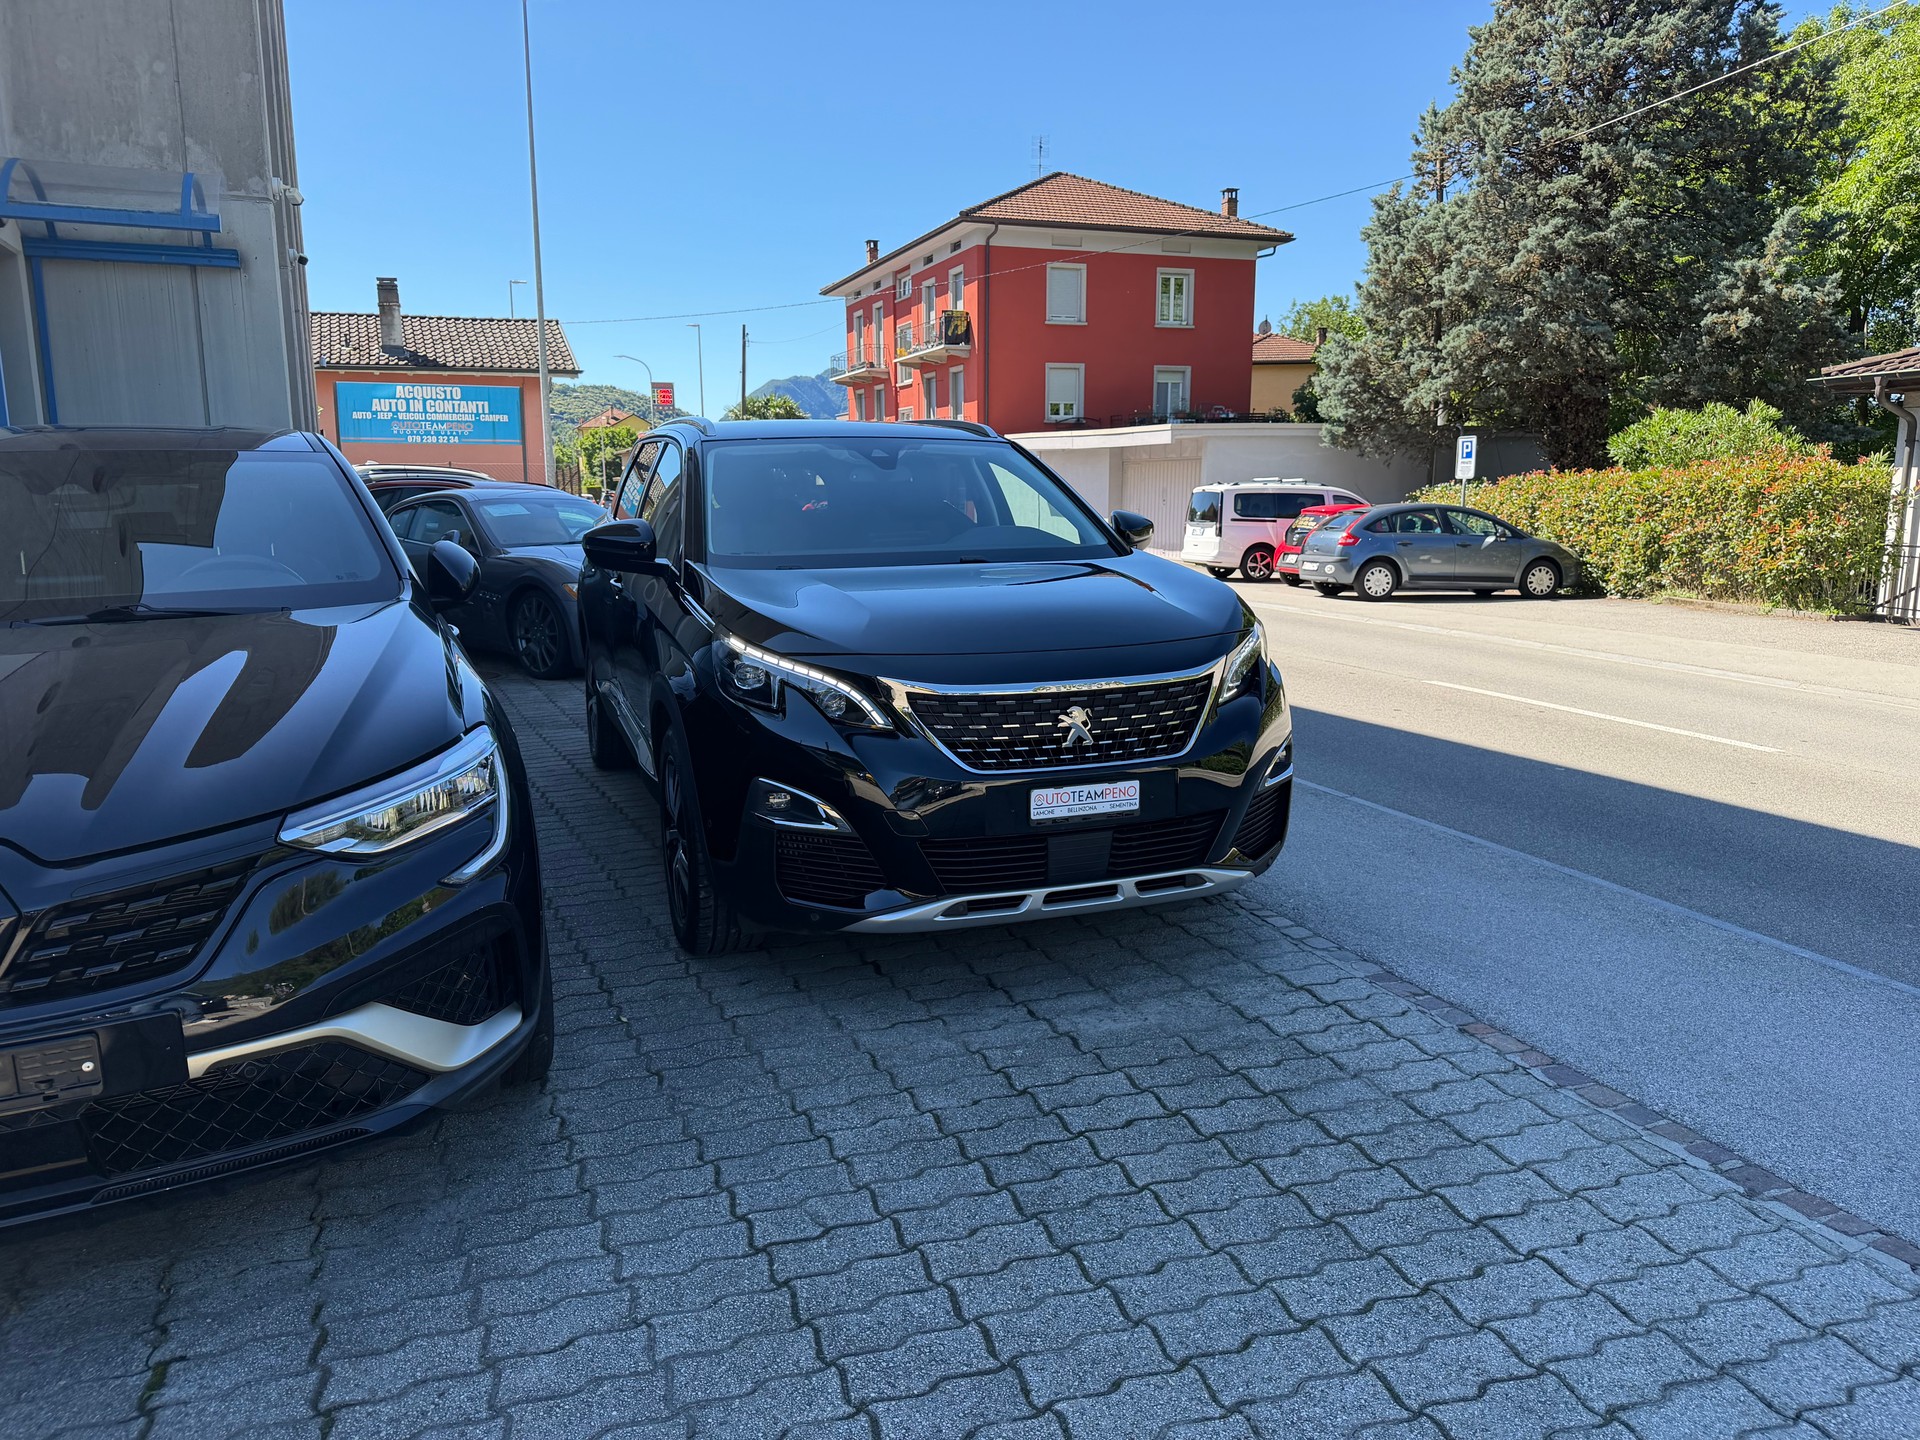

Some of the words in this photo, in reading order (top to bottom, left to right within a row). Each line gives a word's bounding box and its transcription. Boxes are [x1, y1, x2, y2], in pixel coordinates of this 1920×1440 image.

[395, 385, 461, 400] ACQUISTO
[371, 398, 408, 412] AUTO
[409, 399, 424, 413] IN
[426, 400, 489, 414] CONTANTI
[352, 411, 373, 420] AUTO
[377, 412, 393, 420] JEEP
[398, 412, 426, 421] VEICOLI
[426, 413, 475, 422] COMMERCIALI
[479, 414, 509, 422] CAMPER
[407, 435, 421, 443] 079
[422, 435, 437, 443] 230
[1463, 441, 1472, 458] P
[1033, 809, 1055, 817] LAMONE
[1067, 805, 1098, 813] BELLINZONA
[1109, 801, 1138, 809] SEMENTINA
